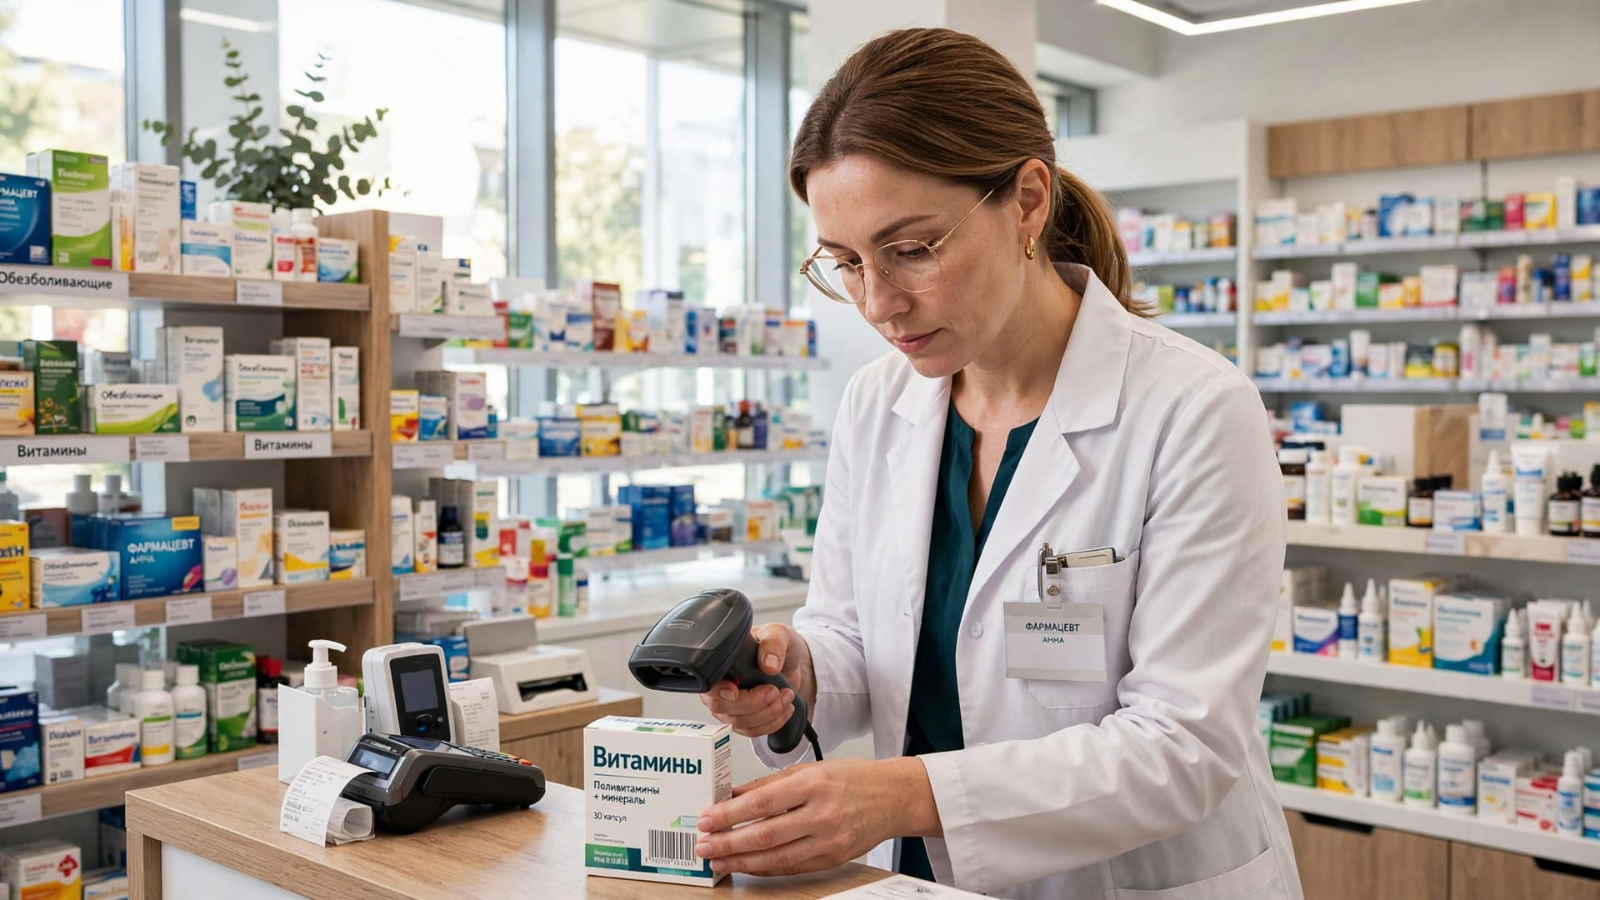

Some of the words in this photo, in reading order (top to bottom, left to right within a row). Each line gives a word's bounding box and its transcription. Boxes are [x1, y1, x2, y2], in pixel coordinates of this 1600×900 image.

[0, 271, 113, 290] Обезболивающие
[17, 444, 87, 458] Витамины
[254, 438, 313, 451] Витамины
[127, 538, 195, 554] ФАРМАЦЕВТ
[1025, 622, 1080, 633] ФАРМАЦЕВТ
[1042, 636, 1065, 644] АННА
[593, 745, 702, 775] Витамины
[593, 780, 660, 795] Поливитамины
[601, 794, 646, 806] минералы
[593, 811, 602, 820] 30
[603, 814, 627, 824] капсул
